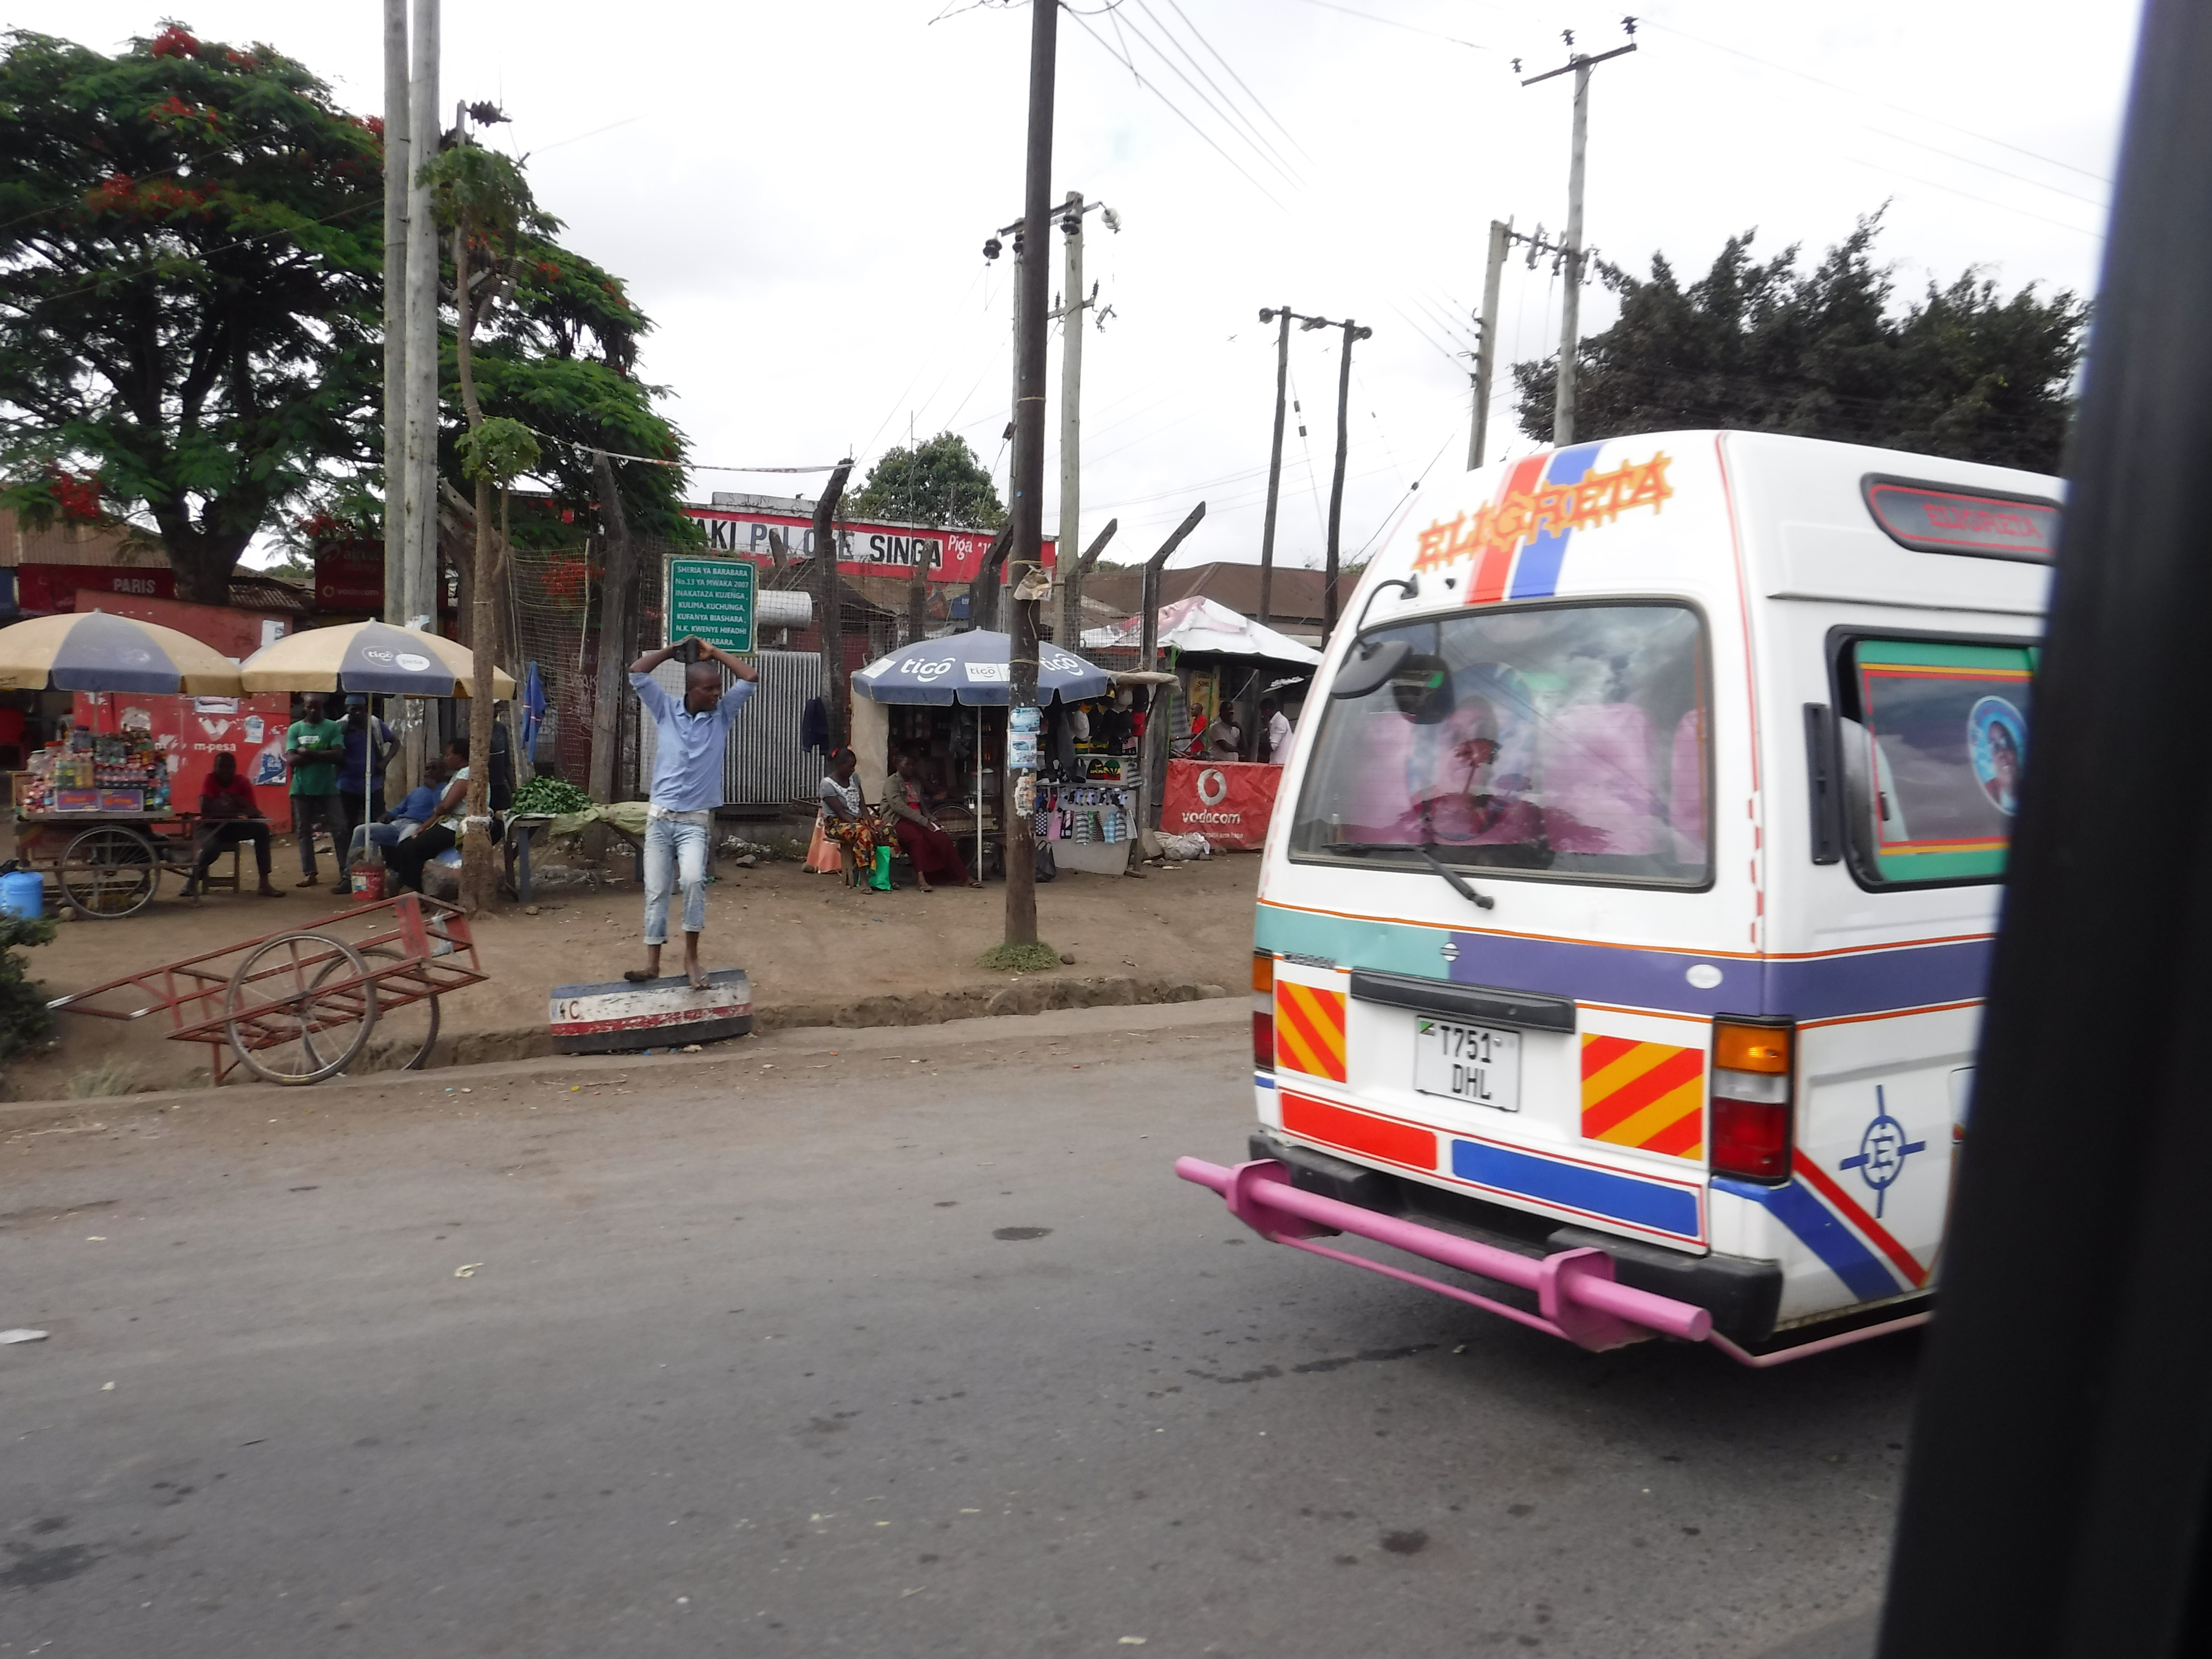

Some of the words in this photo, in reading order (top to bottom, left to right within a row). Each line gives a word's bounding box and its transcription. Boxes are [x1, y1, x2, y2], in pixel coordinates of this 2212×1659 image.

[948, 534, 973, 561] Piga
[712, 568, 748, 577] BARABARA
[114, 578, 156, 593] PARIS
[901, 658, 956, 682] tigo
[194, 743, 237, 753] m-pesa
[1181, 809, 1241, 824] vodacom
[1440, 1025, 1491, 1063] T751
[1453, 1063, 1491, 1100] DHL
